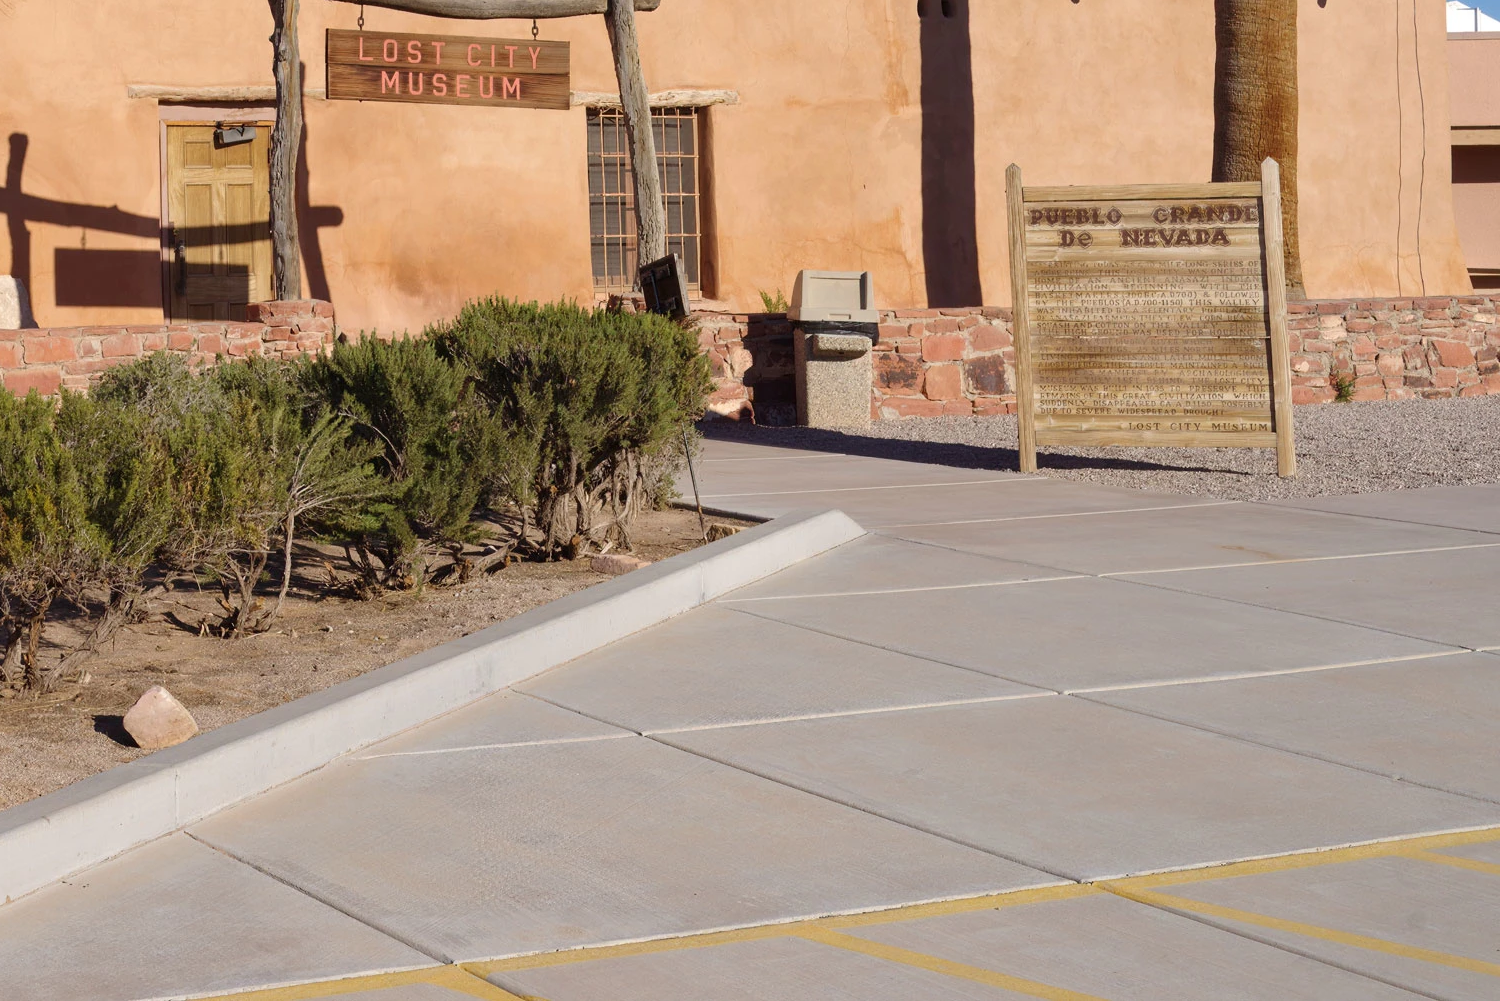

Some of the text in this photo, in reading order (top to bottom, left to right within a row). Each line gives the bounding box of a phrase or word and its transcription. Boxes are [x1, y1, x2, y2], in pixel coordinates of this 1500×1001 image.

[358, 36, 542, 70] LOST CITY
[381, 70, 522, 101] MUSEUM
[1028, 204, 1260, 227] PUEBLO GRANDE
[1058, 228, 1232, 249] De NEVADA
[1188, 268, 1209, 276] WAS
[1210, 268, 1236, 276] ONCE
[1240, 268, 1260, 276] THE
[1087, 276, 1102, 284] AN
[1109, 276, 1156, 284] ANCIENT
[1164, 276, 1209, 284] ANASAZI
[1221, 276, 1261, 284] INDIAN
[1123, 283, 1184, 291] BEGINNING
[1199, 283, 1229, 291] WITH
[1239, 283, 1260, 291] THE
[1202, 291, 1211, 299] &
[1214, 291, 1260, 299] FOLLOWED
[1064, 328, 1087, 336] HIGH
[1132, 328, 1152, 336] WAS
[1156, 328, 1181, 336] USED
[1186, 328, 1204, 336] FOR
[1140, 353, 1160, 361] AND
[1170, 361, 1228, 369] MAINTAINED
[1232, 361, 1239, 369] A
[1191, 376, 1211, 385] THE
[1213, 376, 1238, 385] LOST
[1239, 376, 1266, 385] CITY
[1039, 385, 1077, 393] MUSEUM
[1079, 385, 1099, 393] WAS
[1102, 385, 1127, 393] BUILT
[1145, 385, 1166, 393] 1935
[1169, 385, 1182, 393] TO
[1188, 385, 1237, 393] PRESERVE
[1246, 385, 1266, 393] THE
[1040, 392, 1266, 400] REMAINS OF THIS GREAT CIVILIZATION WHICH
[1039, 399, 1088, 408] SUDDENLY
[1092, 399, 1157, 408] DISAPPEARED
[1220, 400, 1266, 408] POSSIBLY
[1040, 407, 1058, 416] DUE
[1060, 407, 1073, 416] TO
[1075, 407, 1112, 416] SEVERE
[1116, 407, 1178, 416] WIDESPREAD
[1128, 422, 1269, 433] LOST CITY MUSEUM
